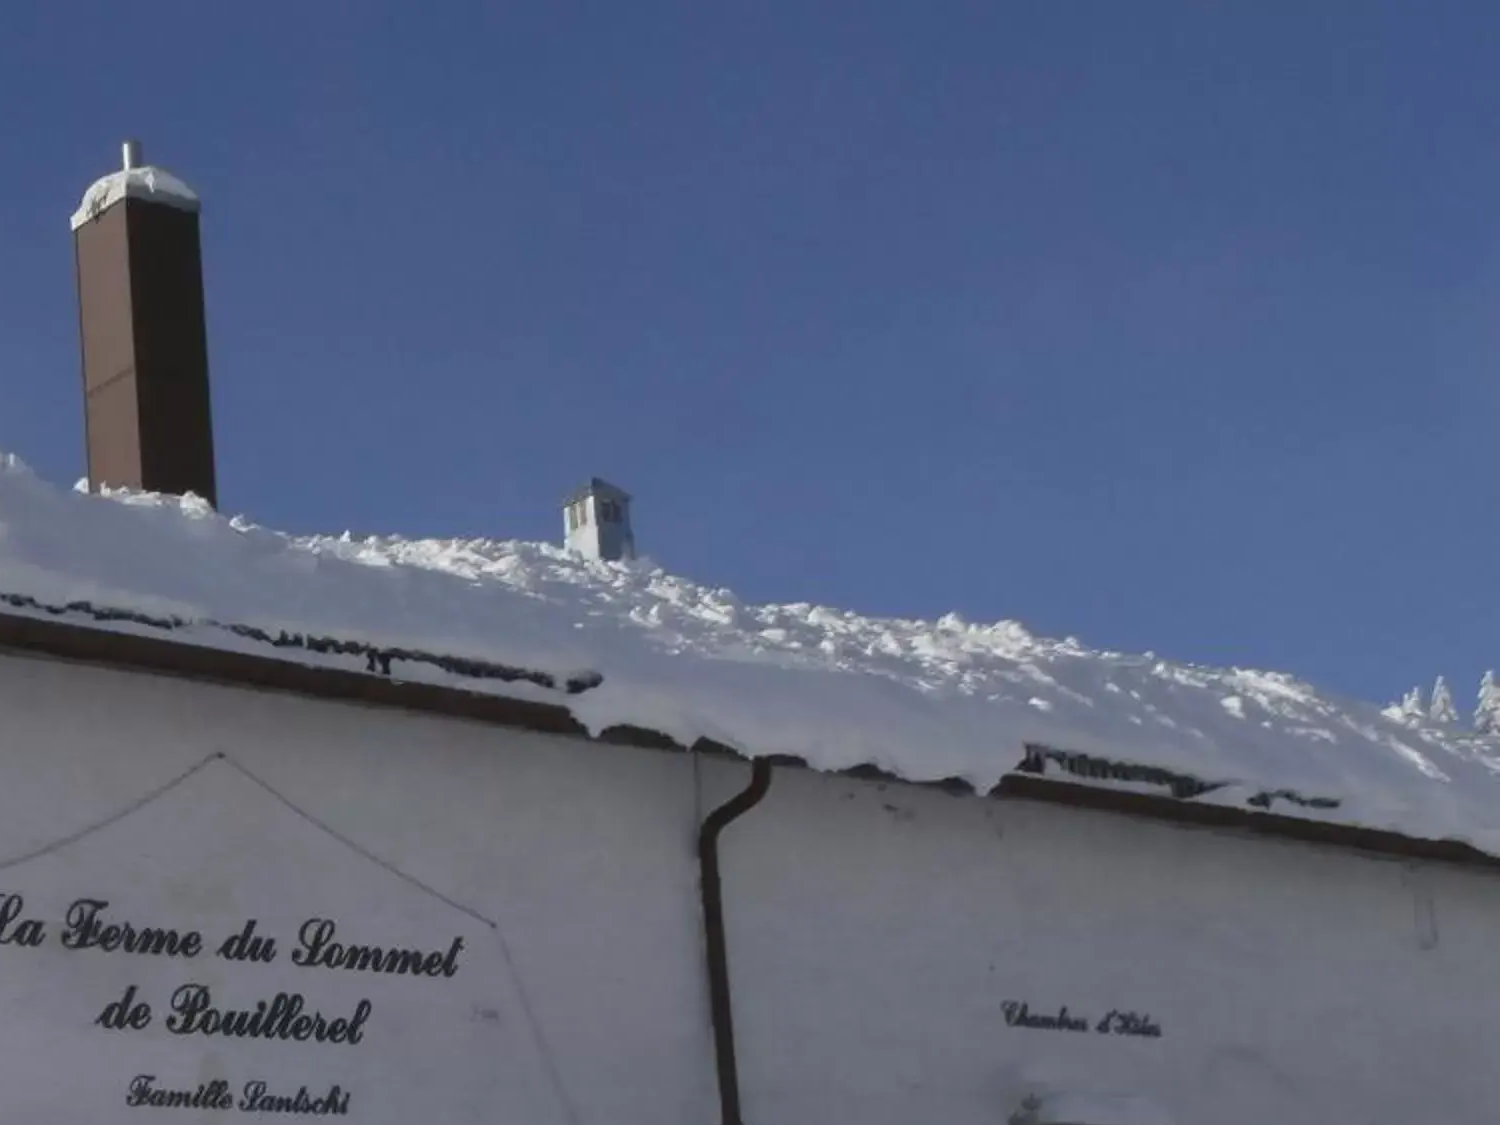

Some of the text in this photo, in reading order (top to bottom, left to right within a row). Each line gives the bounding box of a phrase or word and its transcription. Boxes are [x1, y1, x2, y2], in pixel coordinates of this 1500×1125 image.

[61, 898, 203, 958] Ferme
[216, 920, 276, 963] du
[291, 918, 464, 978] Sommet
[95, 983, 371, 1045] de Pouillerel
[126, 1074, 232, 1111] Famille
